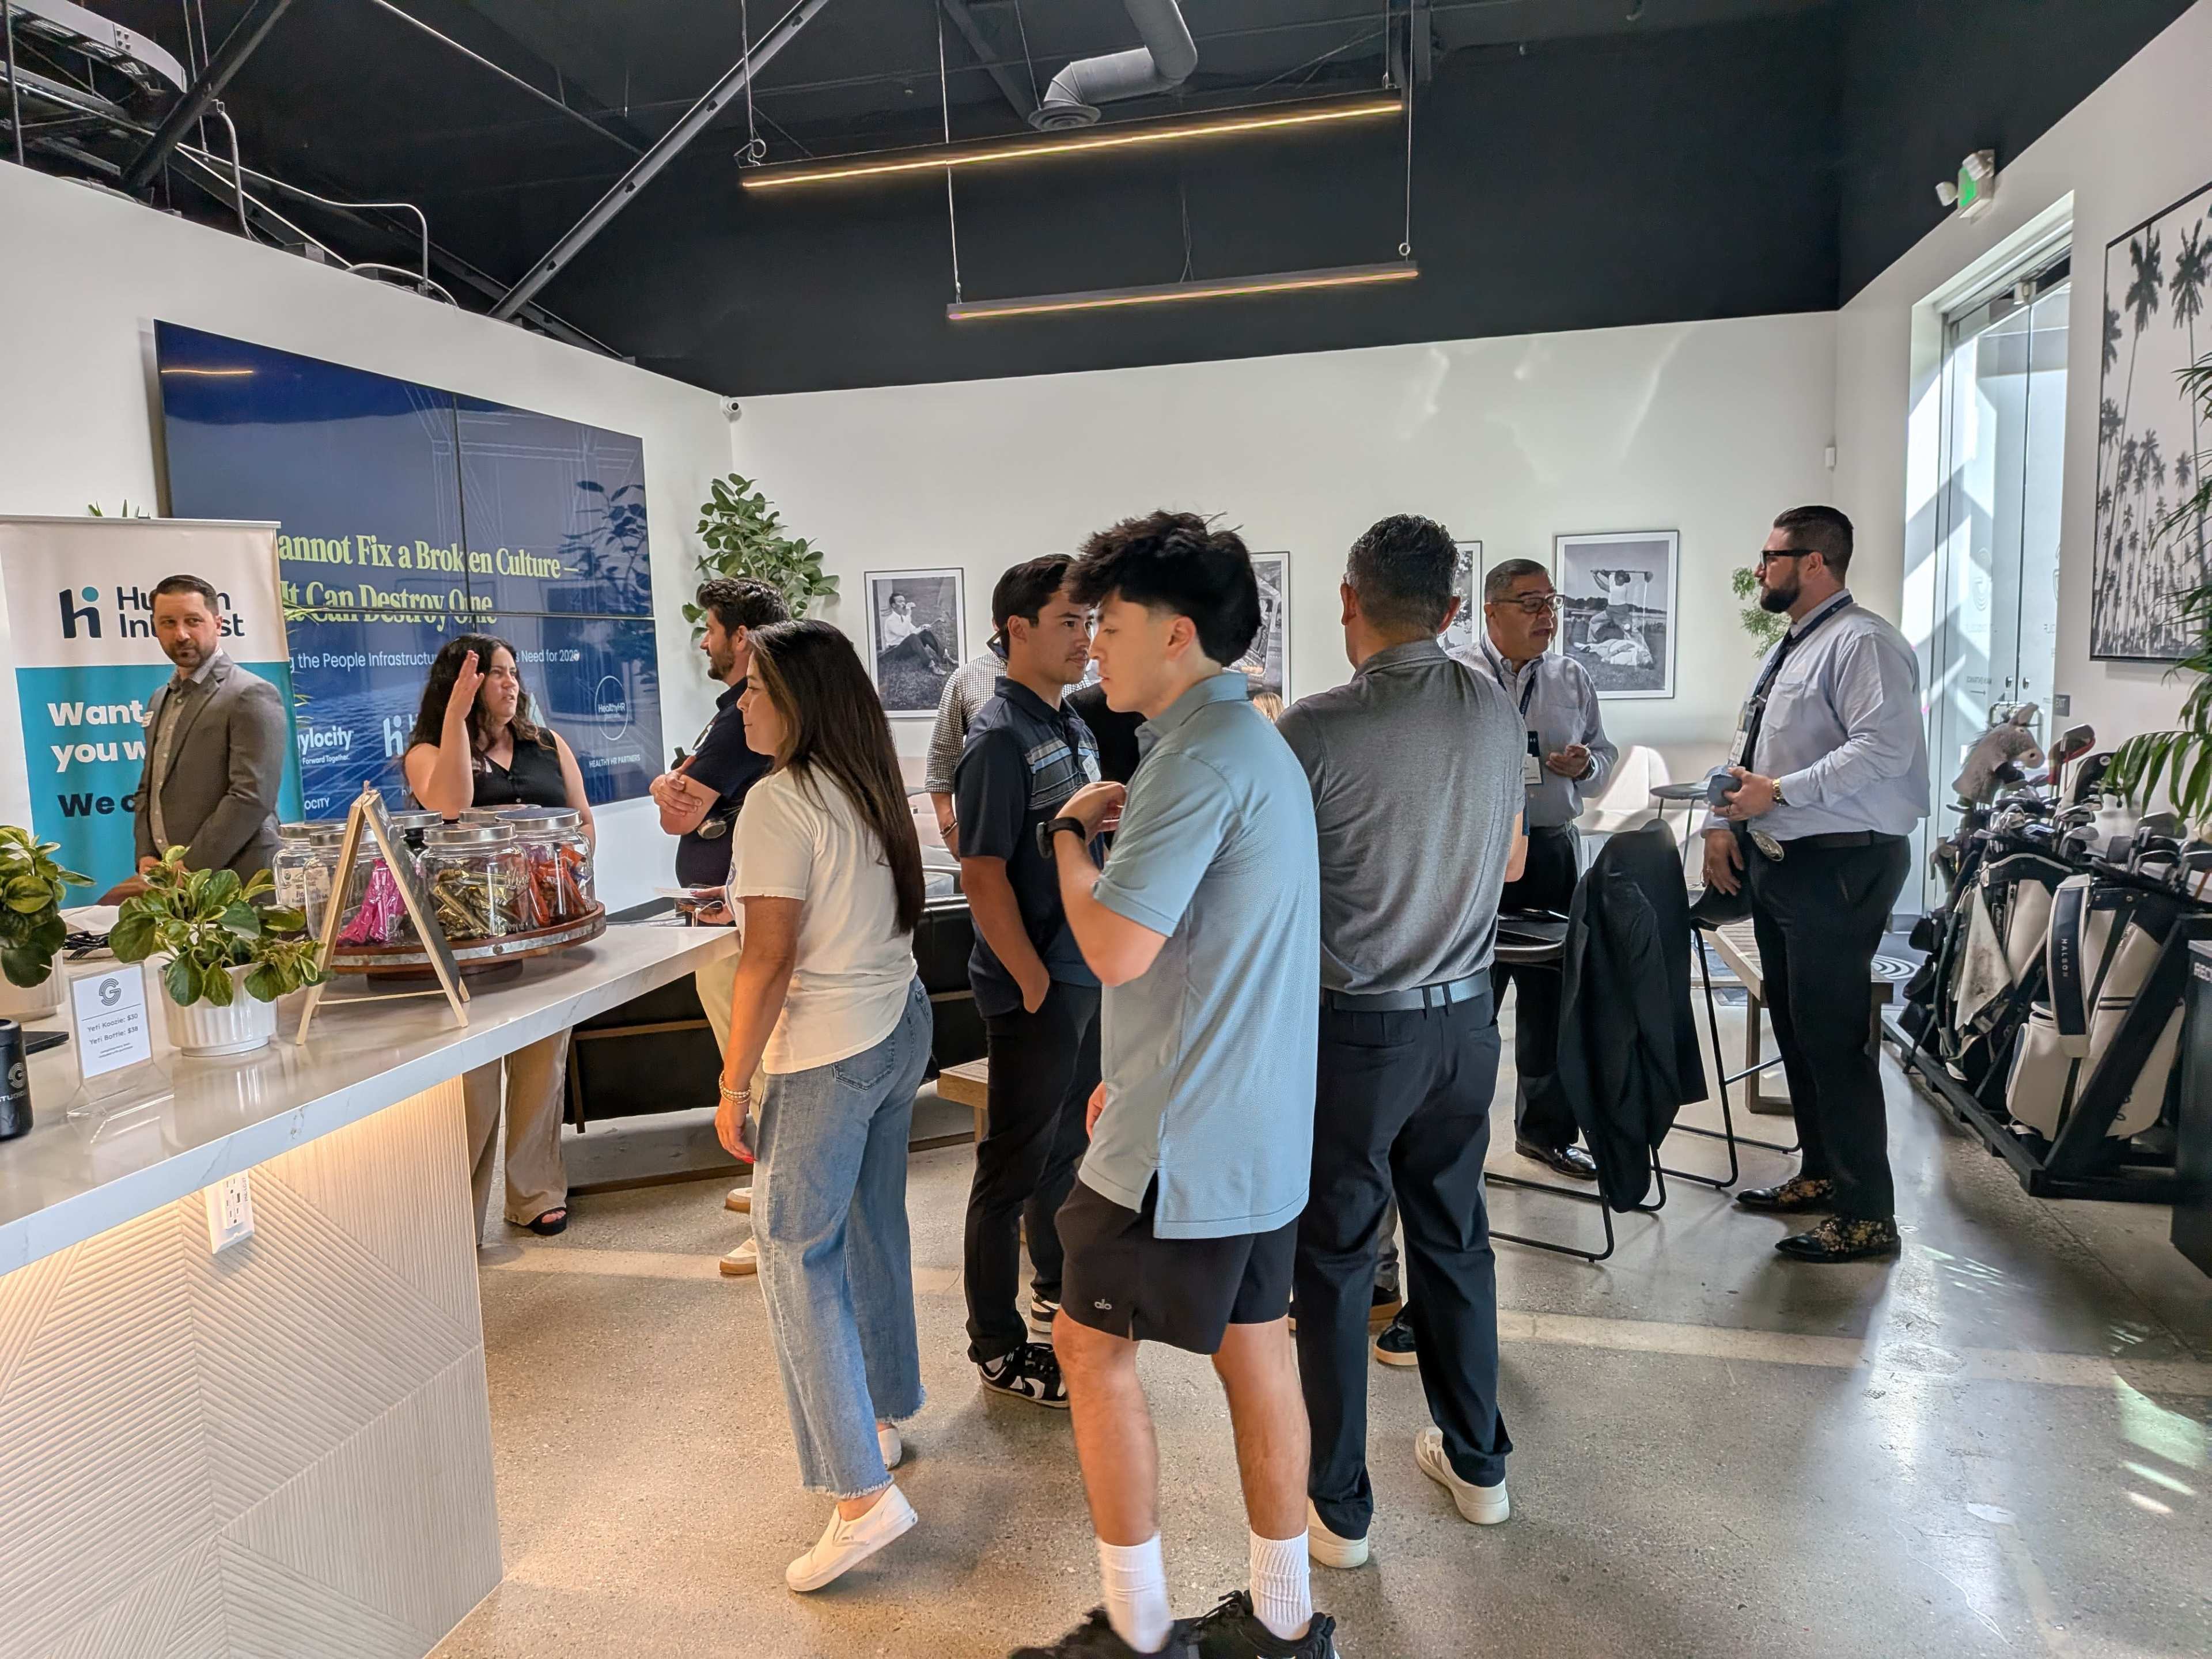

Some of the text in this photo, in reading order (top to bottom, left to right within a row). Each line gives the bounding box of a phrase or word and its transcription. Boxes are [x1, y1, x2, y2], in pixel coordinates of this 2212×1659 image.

[356, 535, 394, 567] Fix
[398, 546, 412, 569] a
[414, 540, 494, 574] Broken
[496, 548, 561, 579] Culture
[116, 586, 231, 611] Hun
[306, 581, 358, 622] Can
[359, 584, 446, 632] Destroy
[449, 589, 497, 624] One
[298, 653, 320, 669] the
[323, 652, 366, 672] People
[521, 650, 544, 662] Need
[546, 649, 558, 662] for
[47, 700, 145, 726] Want
[298, 726, 352, 755] ylocity
[51, 742, 118, 772] you
[302, 756, 325, 765] Forward
[57, 793, 115, 817] We
[88, 1023, 101, 1033] Yeti
[127, 1013, 138, 1021] $30
[89, 1025, 139, 1045] Yeti Bottle: $38
[1094, 1298, 1112, 1310] alo
